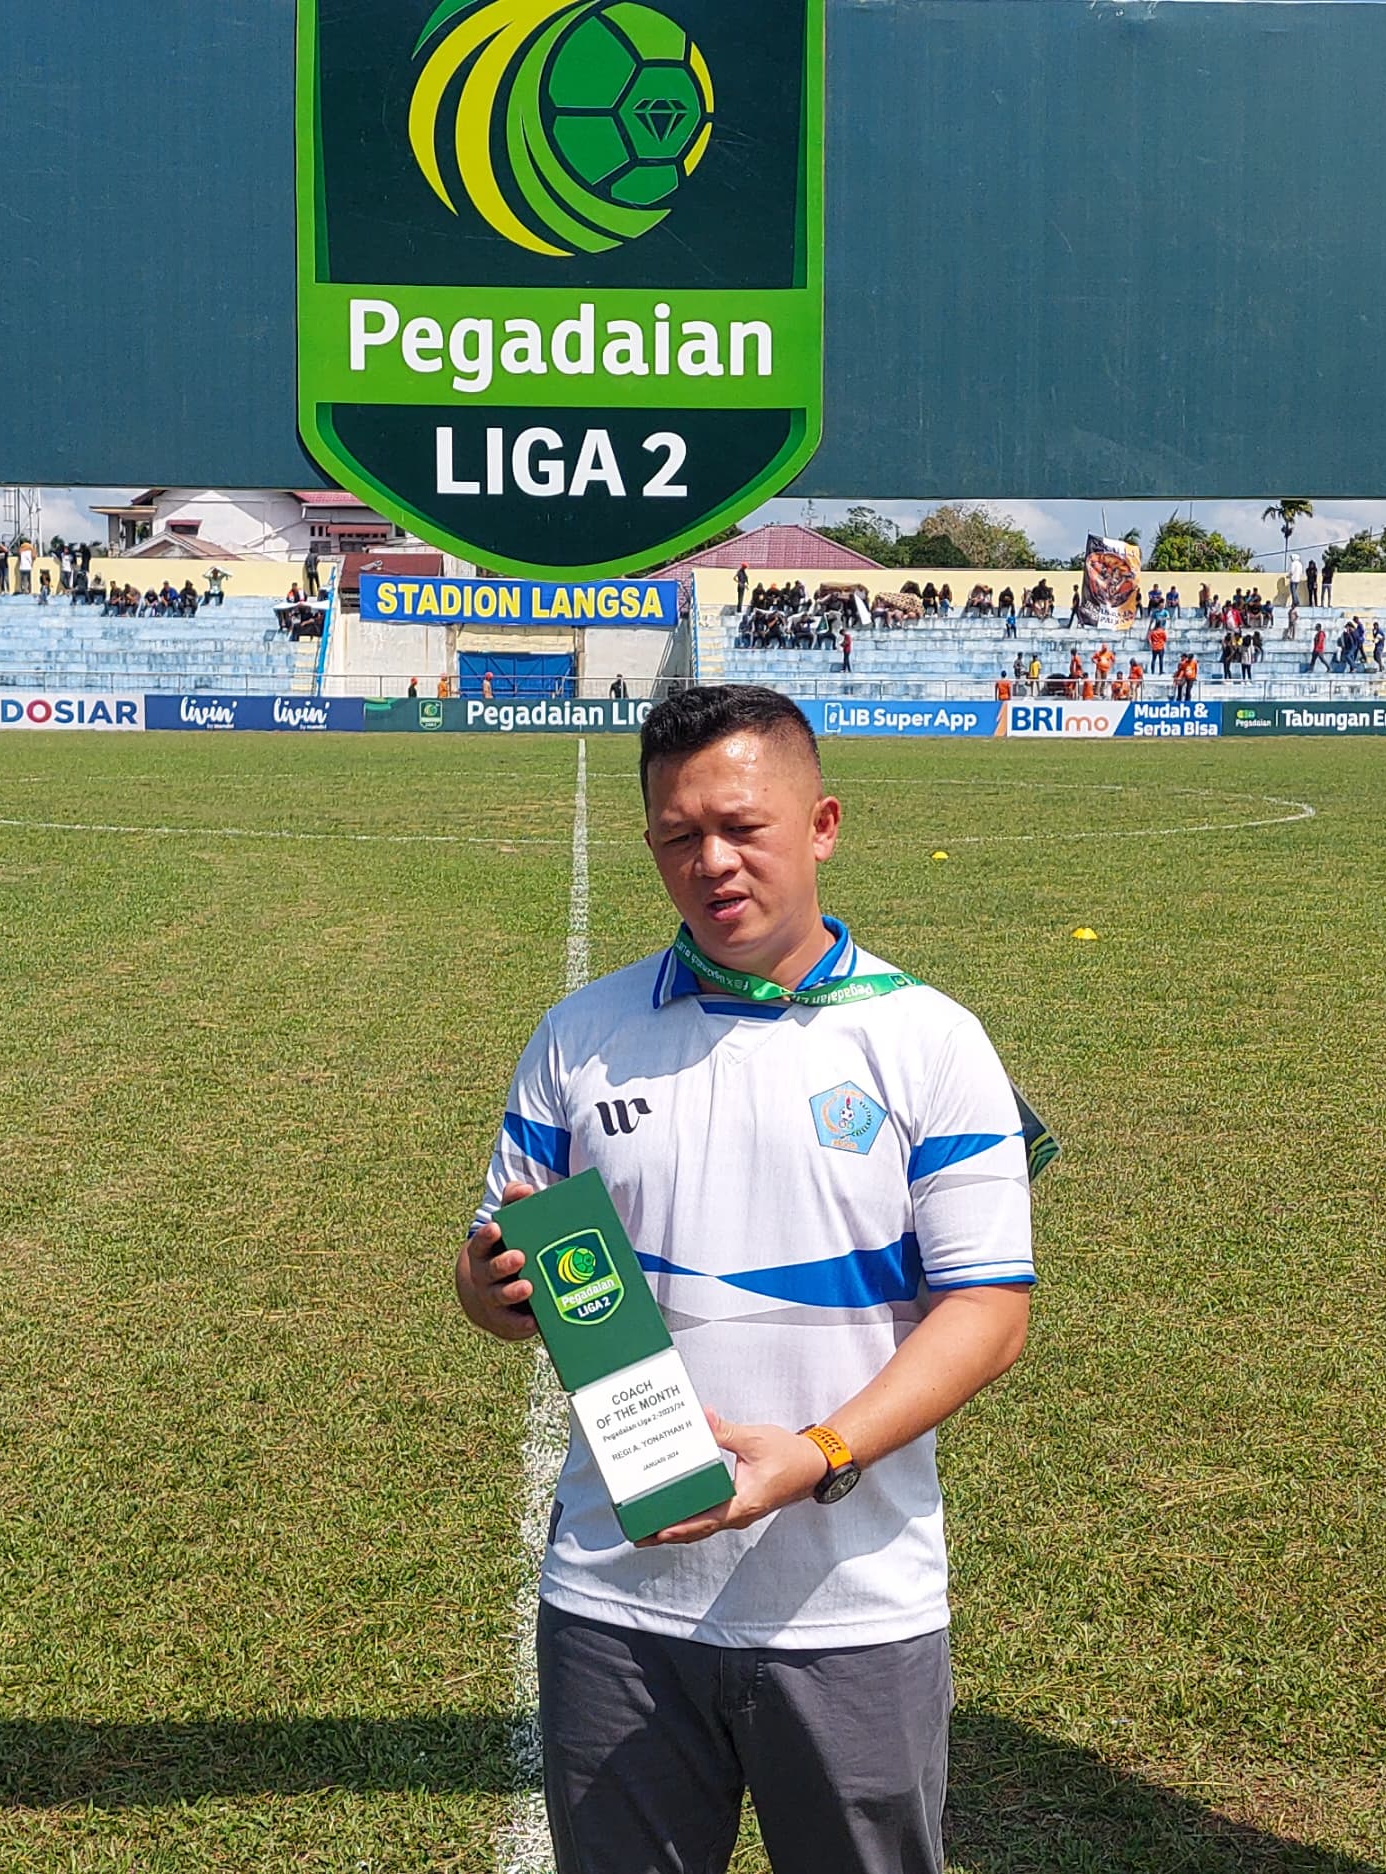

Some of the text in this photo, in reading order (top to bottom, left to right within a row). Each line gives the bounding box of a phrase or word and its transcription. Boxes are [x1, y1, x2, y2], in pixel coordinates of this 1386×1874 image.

[348, 298, 773, 394] Pegadaian
[435, 426, 689, 498] LIGA 2
[376, 582, 664, 618] STADION LANGSA
[180, 696, 238, 726] livin'
[273, 696, 331, 727] livin'
[467, 701, 653, 731] Pegadaian LIG
[839, 705, 977, 731] LIB Super App
[1011, 706, 1108, 732] BRImo
[1134, 703, 1209, 719] Mudah &
[1281, 709, 1370, 731] Tabungan
[1133, 721, 1218, 736] Serba Bisa
[560, 1278, 616, 1308] Pegadaian
[577, 1296, 612, 1319] LIGA 2
[596, 1384, 681, 1430] OF THE MONTH
[611, 1379, 654, 1406] COACH
[602, 1423, 637, 1443] Pegadaian
[611, 1447, 633, 1462] REGI
[641, 1422, 686, 1448] YONATHAN
[685, 1419, 693, 1429] H
